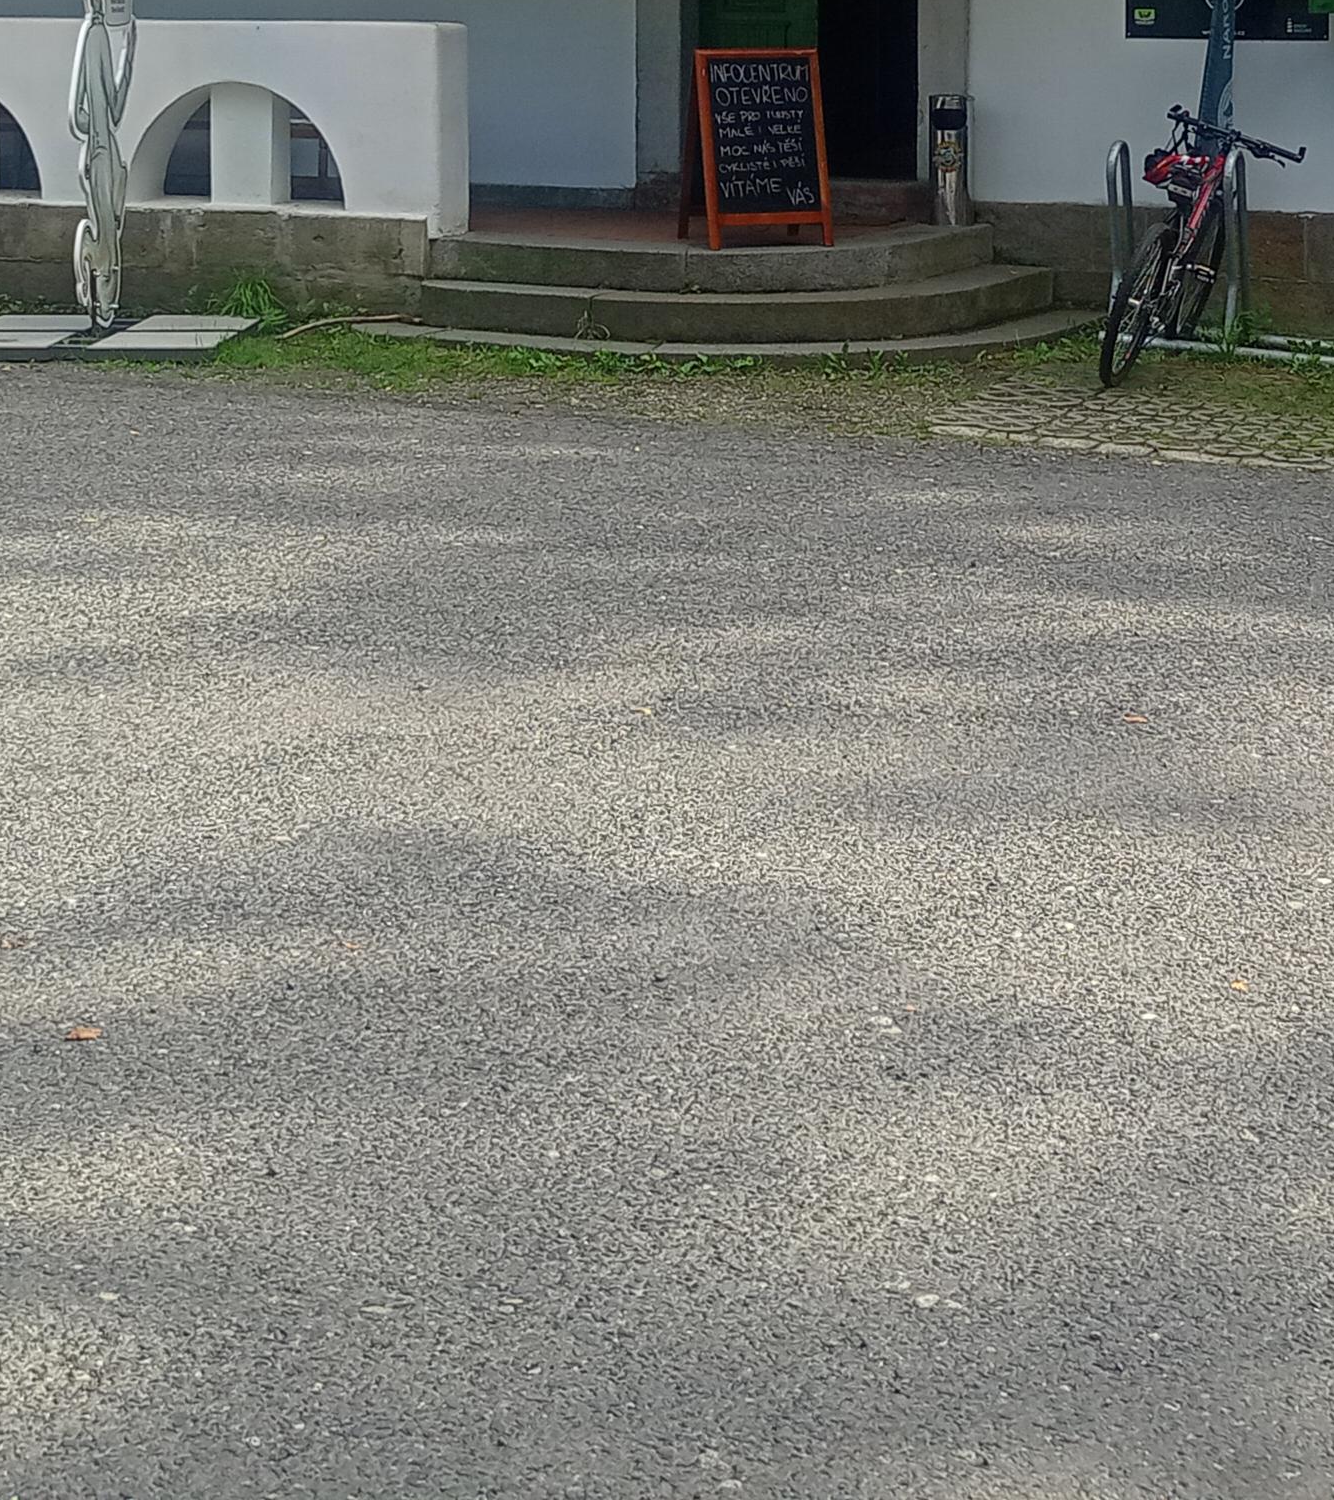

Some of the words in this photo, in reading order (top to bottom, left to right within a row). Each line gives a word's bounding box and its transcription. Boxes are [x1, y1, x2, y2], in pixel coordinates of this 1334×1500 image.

[710, 63, 809, 84] INFOCENTRUM
[715, 85, 808, 106] OTEVŘENO
[715, 110, 736, 124] VŠE
[740, 110, 761, 122] PRO
[719, 123, 754, 138] MALÉ
[720, 145, 750, 157] MOC
[753, 139, 776, 154] NÁS
[720, 174, 782, 198] VÍTÁME
[786, 181, 815, 205] VÁS
